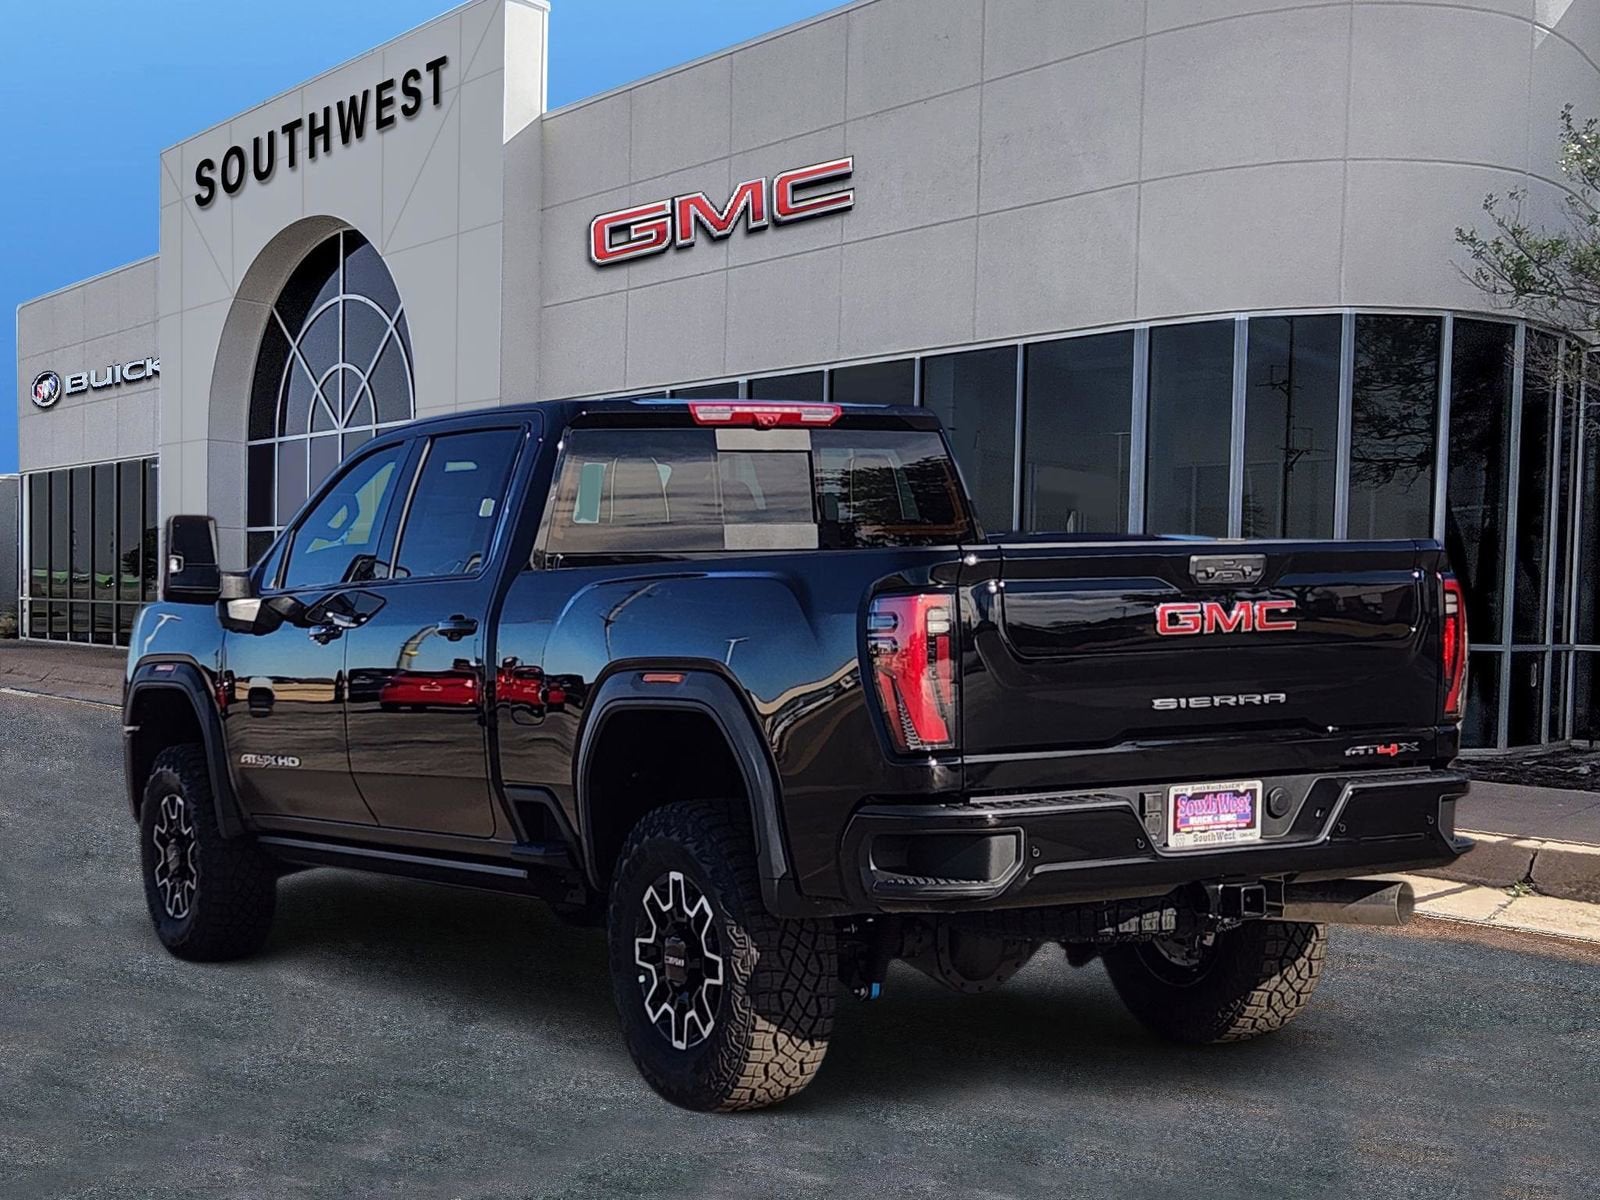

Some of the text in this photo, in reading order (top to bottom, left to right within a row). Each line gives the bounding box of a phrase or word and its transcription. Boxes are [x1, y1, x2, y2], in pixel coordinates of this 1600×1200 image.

[194, 56, 448, 207] SOUTHWEST
[590, 156, 855, 266] GMC
[65, 357, 160, 394] BUICK
[1156, 600, 1297, 636] GMC
[1152, 693, 1286, 710] SIERRA
[1344, 742, 1420, 757] AT4X
